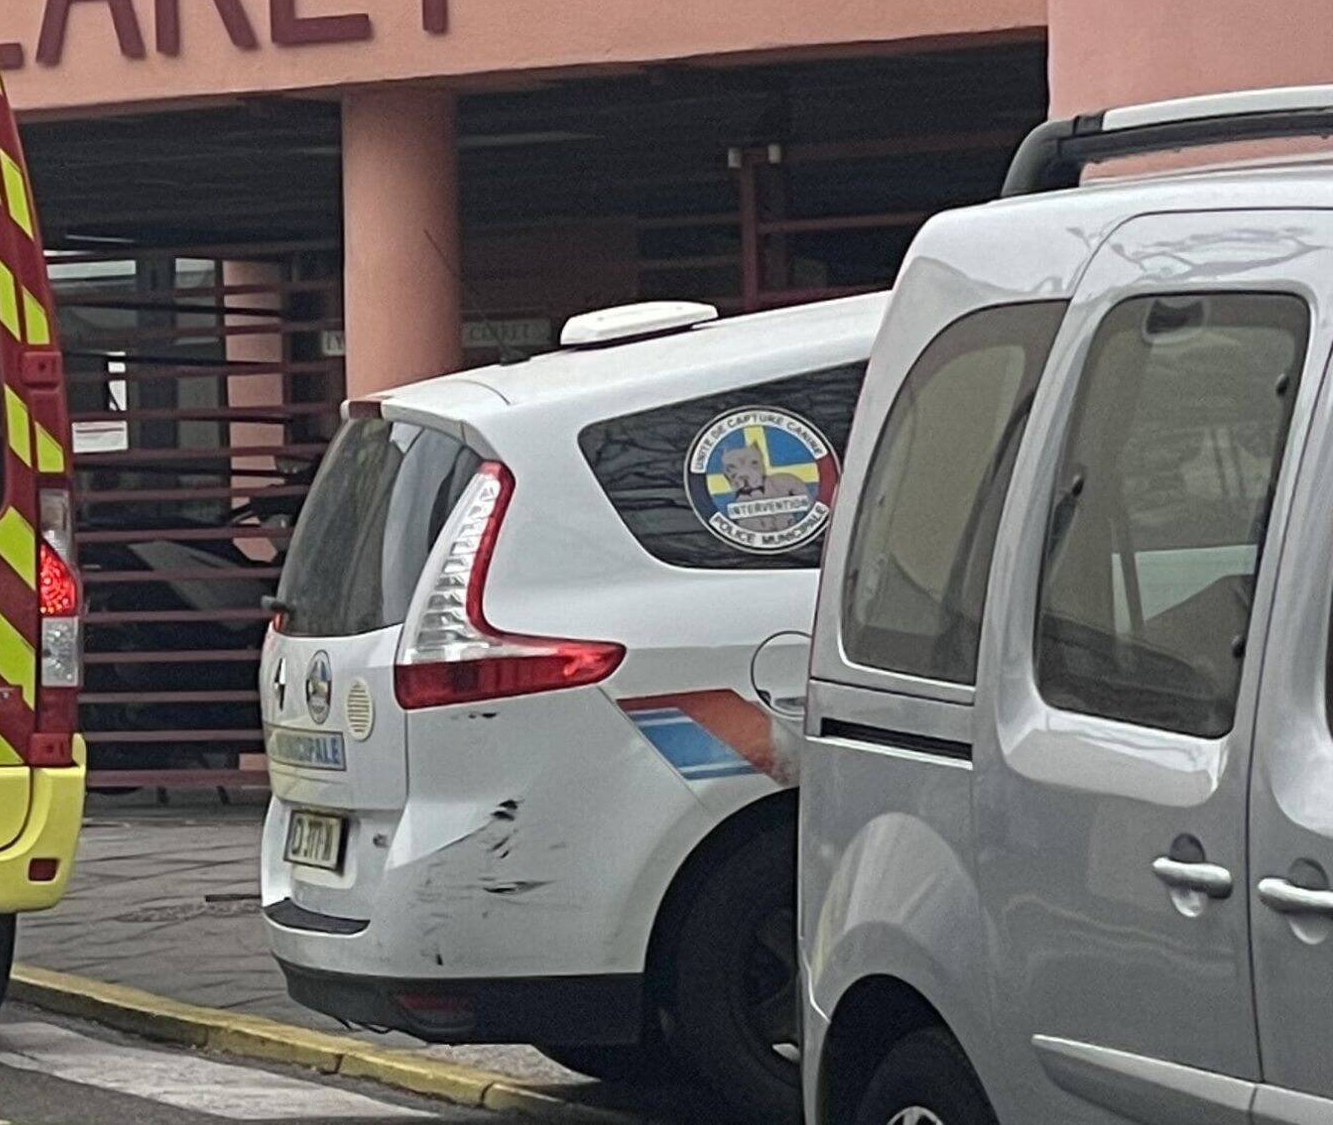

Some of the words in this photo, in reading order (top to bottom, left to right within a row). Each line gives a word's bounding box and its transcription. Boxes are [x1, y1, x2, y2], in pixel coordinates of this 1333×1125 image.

[727, 414, 784, 429] CAPTURE
[730, 497, 808, 516] INTERVENTION
[713, 515, 756, 544] POLICE
[762, 503, 825, 545] MUNICIPALE
